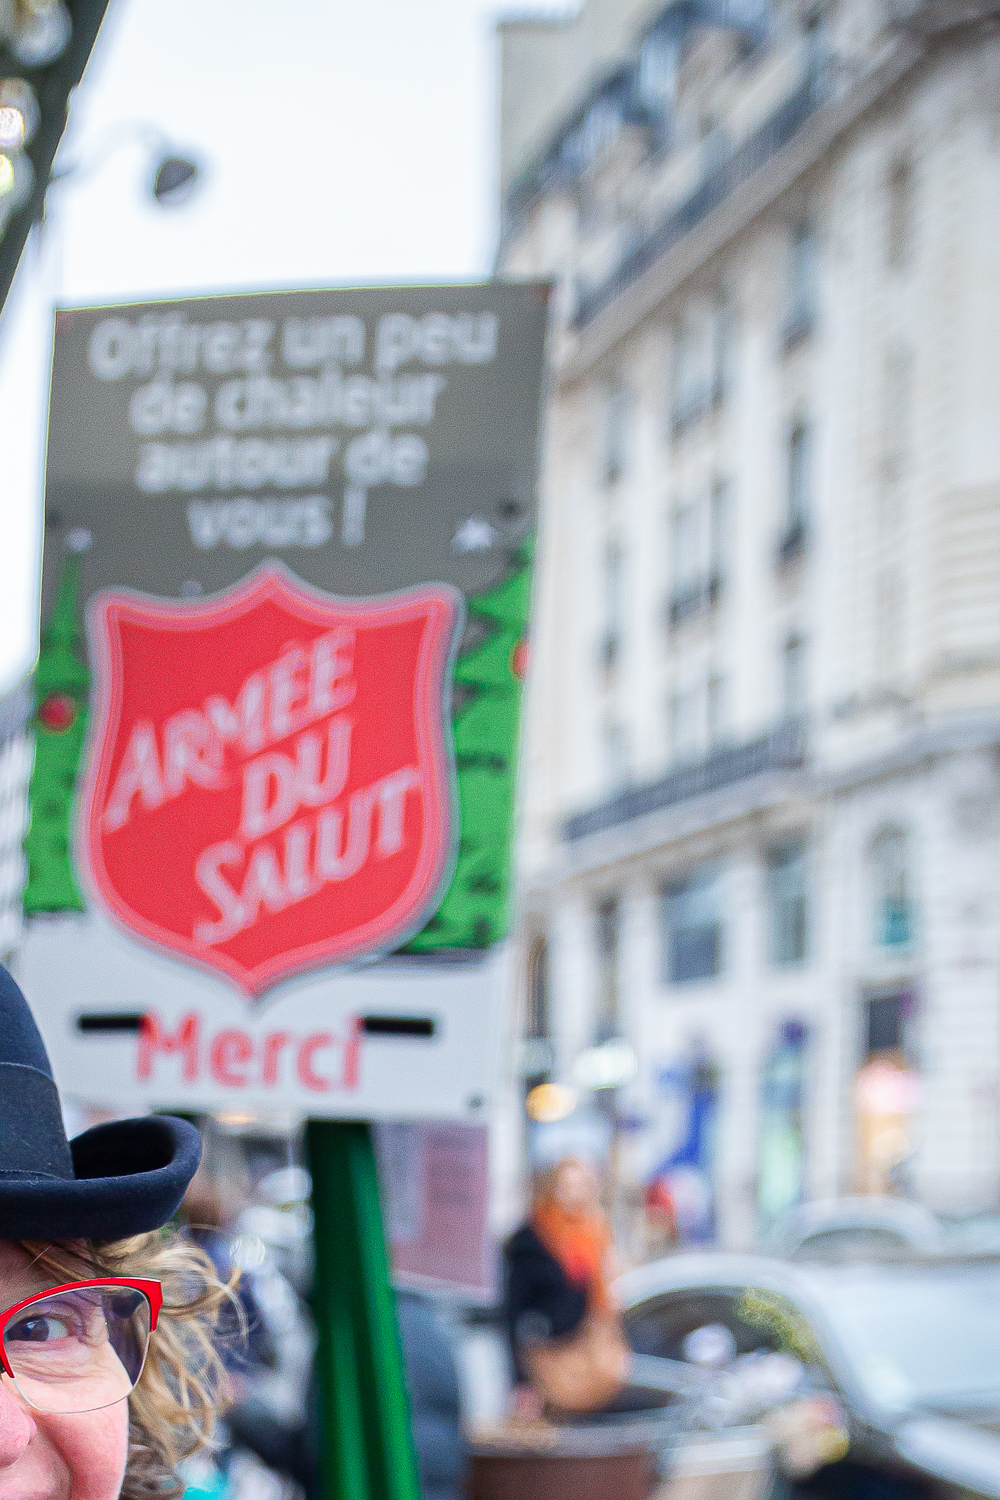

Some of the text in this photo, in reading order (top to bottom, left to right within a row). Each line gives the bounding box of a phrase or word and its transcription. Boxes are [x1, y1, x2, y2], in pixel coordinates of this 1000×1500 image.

[89, 311, 498, 379] Offrez un peu
[129, 364, 446, 434] de chaleur
[135, 427, 429, 493] autour de
[187, 494, 333, 548] vous
[104, 626, 357, 833] ARMÉE
[241, 716, 352, 841] DU
[193, 766, 420, 947] SALUT
[137, 1009, 365, 1091] Merci
